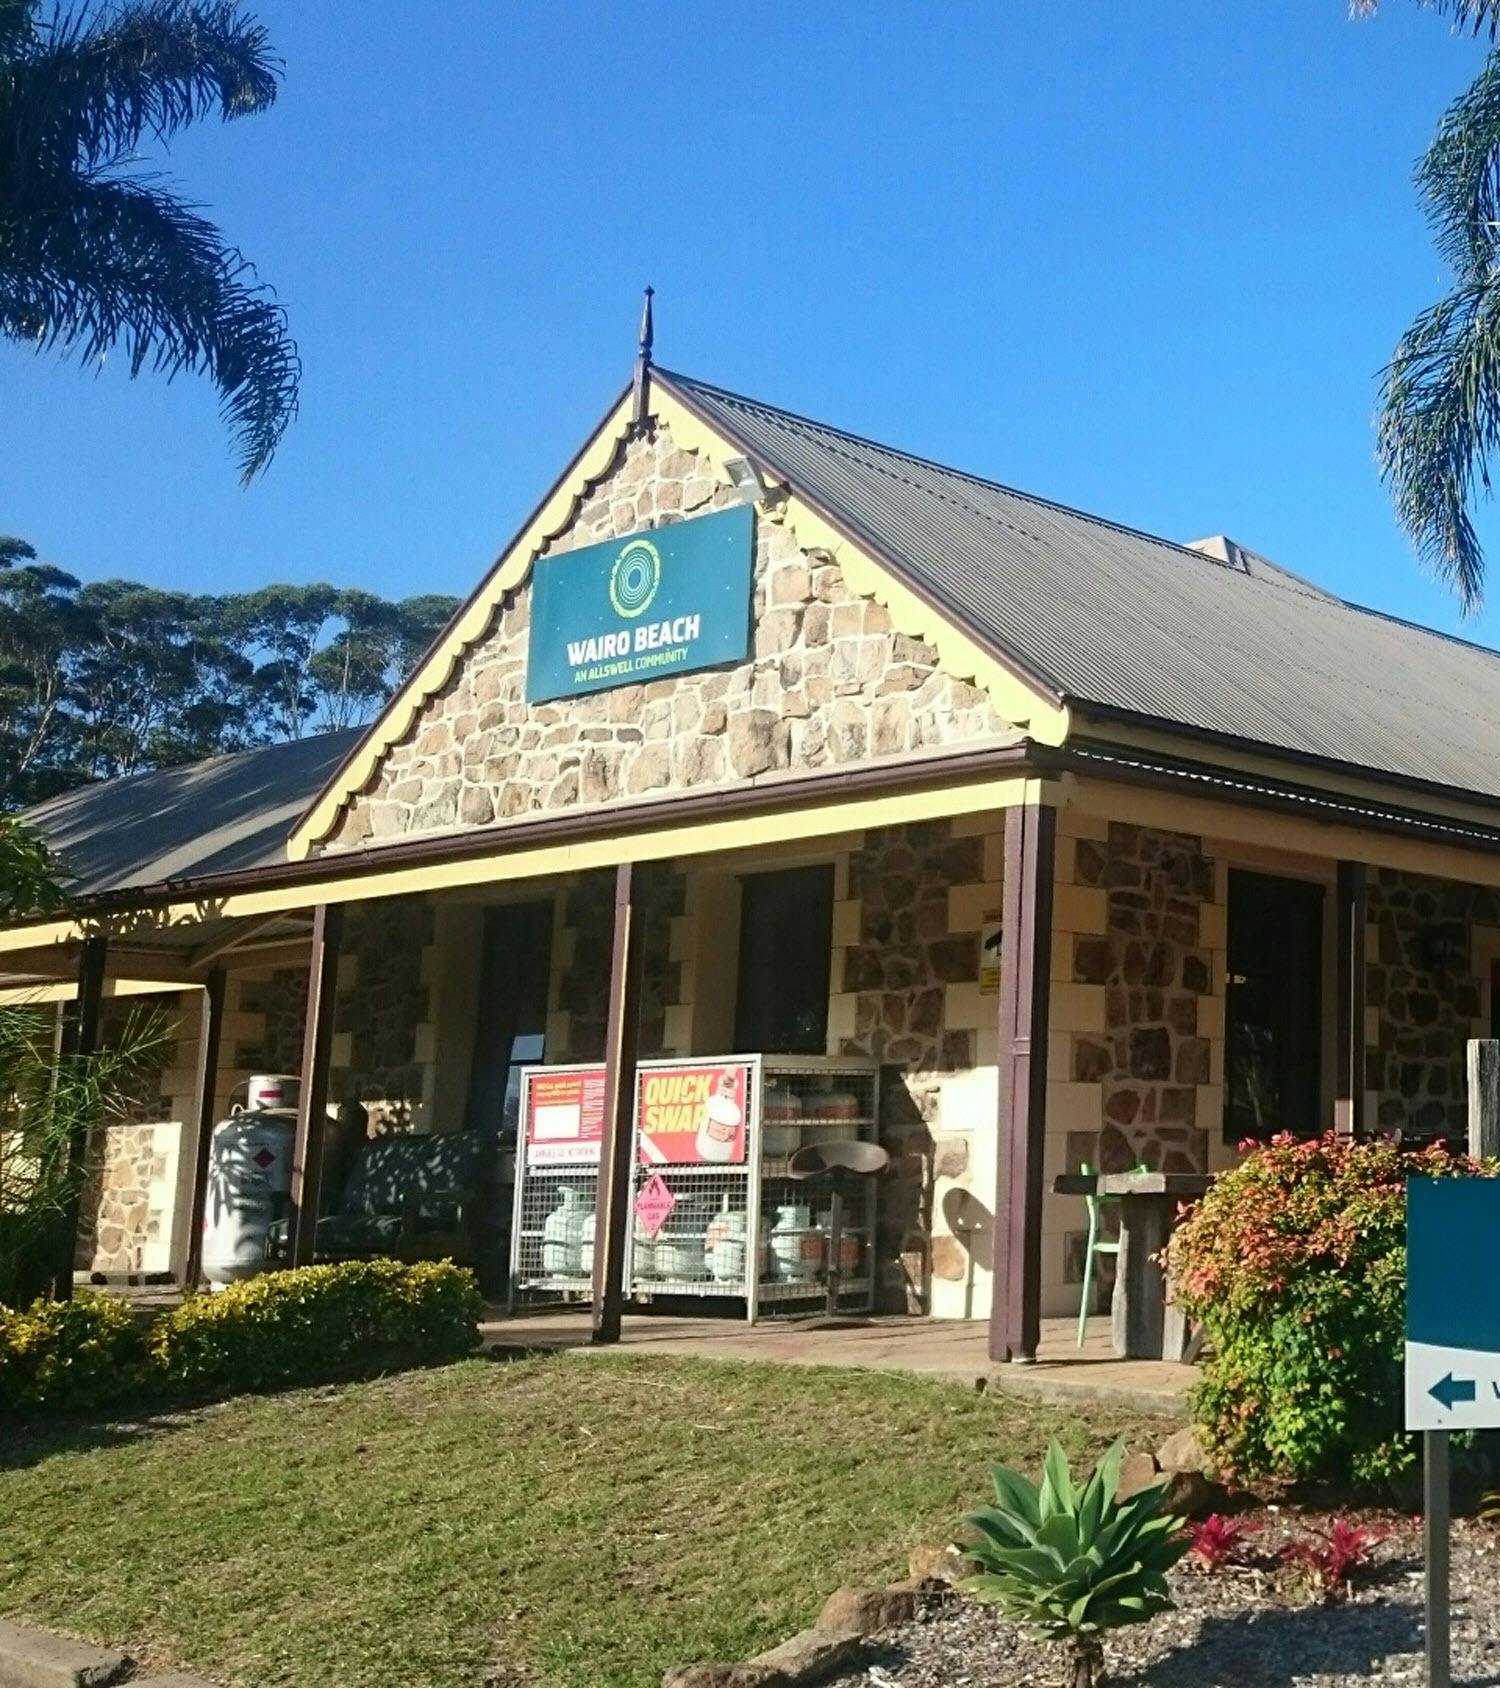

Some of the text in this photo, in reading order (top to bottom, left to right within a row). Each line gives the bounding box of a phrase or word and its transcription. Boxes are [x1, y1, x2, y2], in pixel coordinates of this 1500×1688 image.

[567, 613, 700, 666] WAIRO BEACH
[574, 648, 689, 683] AN ALLSWELL COMMUNITY
[644, 1073, 714, 1105] QUICK
[643, 1104, 706, 1134] SWAP
